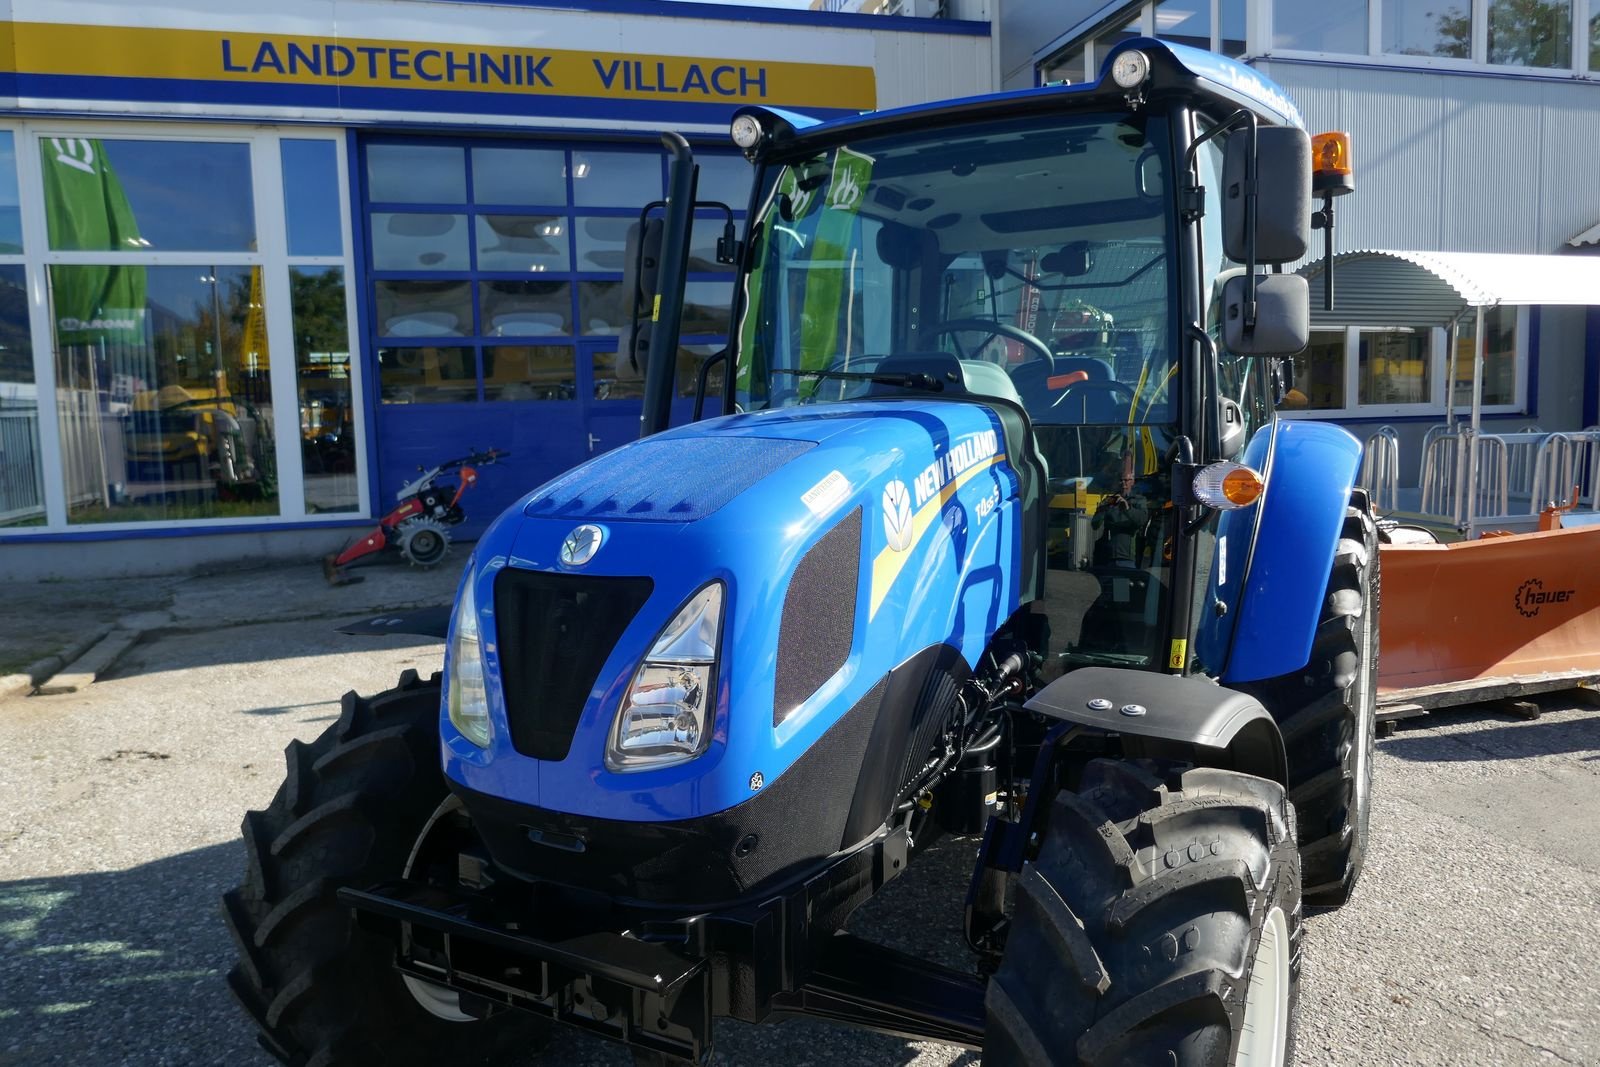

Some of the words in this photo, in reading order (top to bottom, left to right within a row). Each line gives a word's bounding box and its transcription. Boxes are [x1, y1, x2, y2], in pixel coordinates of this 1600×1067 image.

[221, 39, 553, 87] LANDTECHNIK
[593, 59, 767, 97] VILLACH
[913, 457, 945, 507] NEW
[945, 429, 998, 481] HOLLAND
[1524, 587, 1575, 605] hauer
